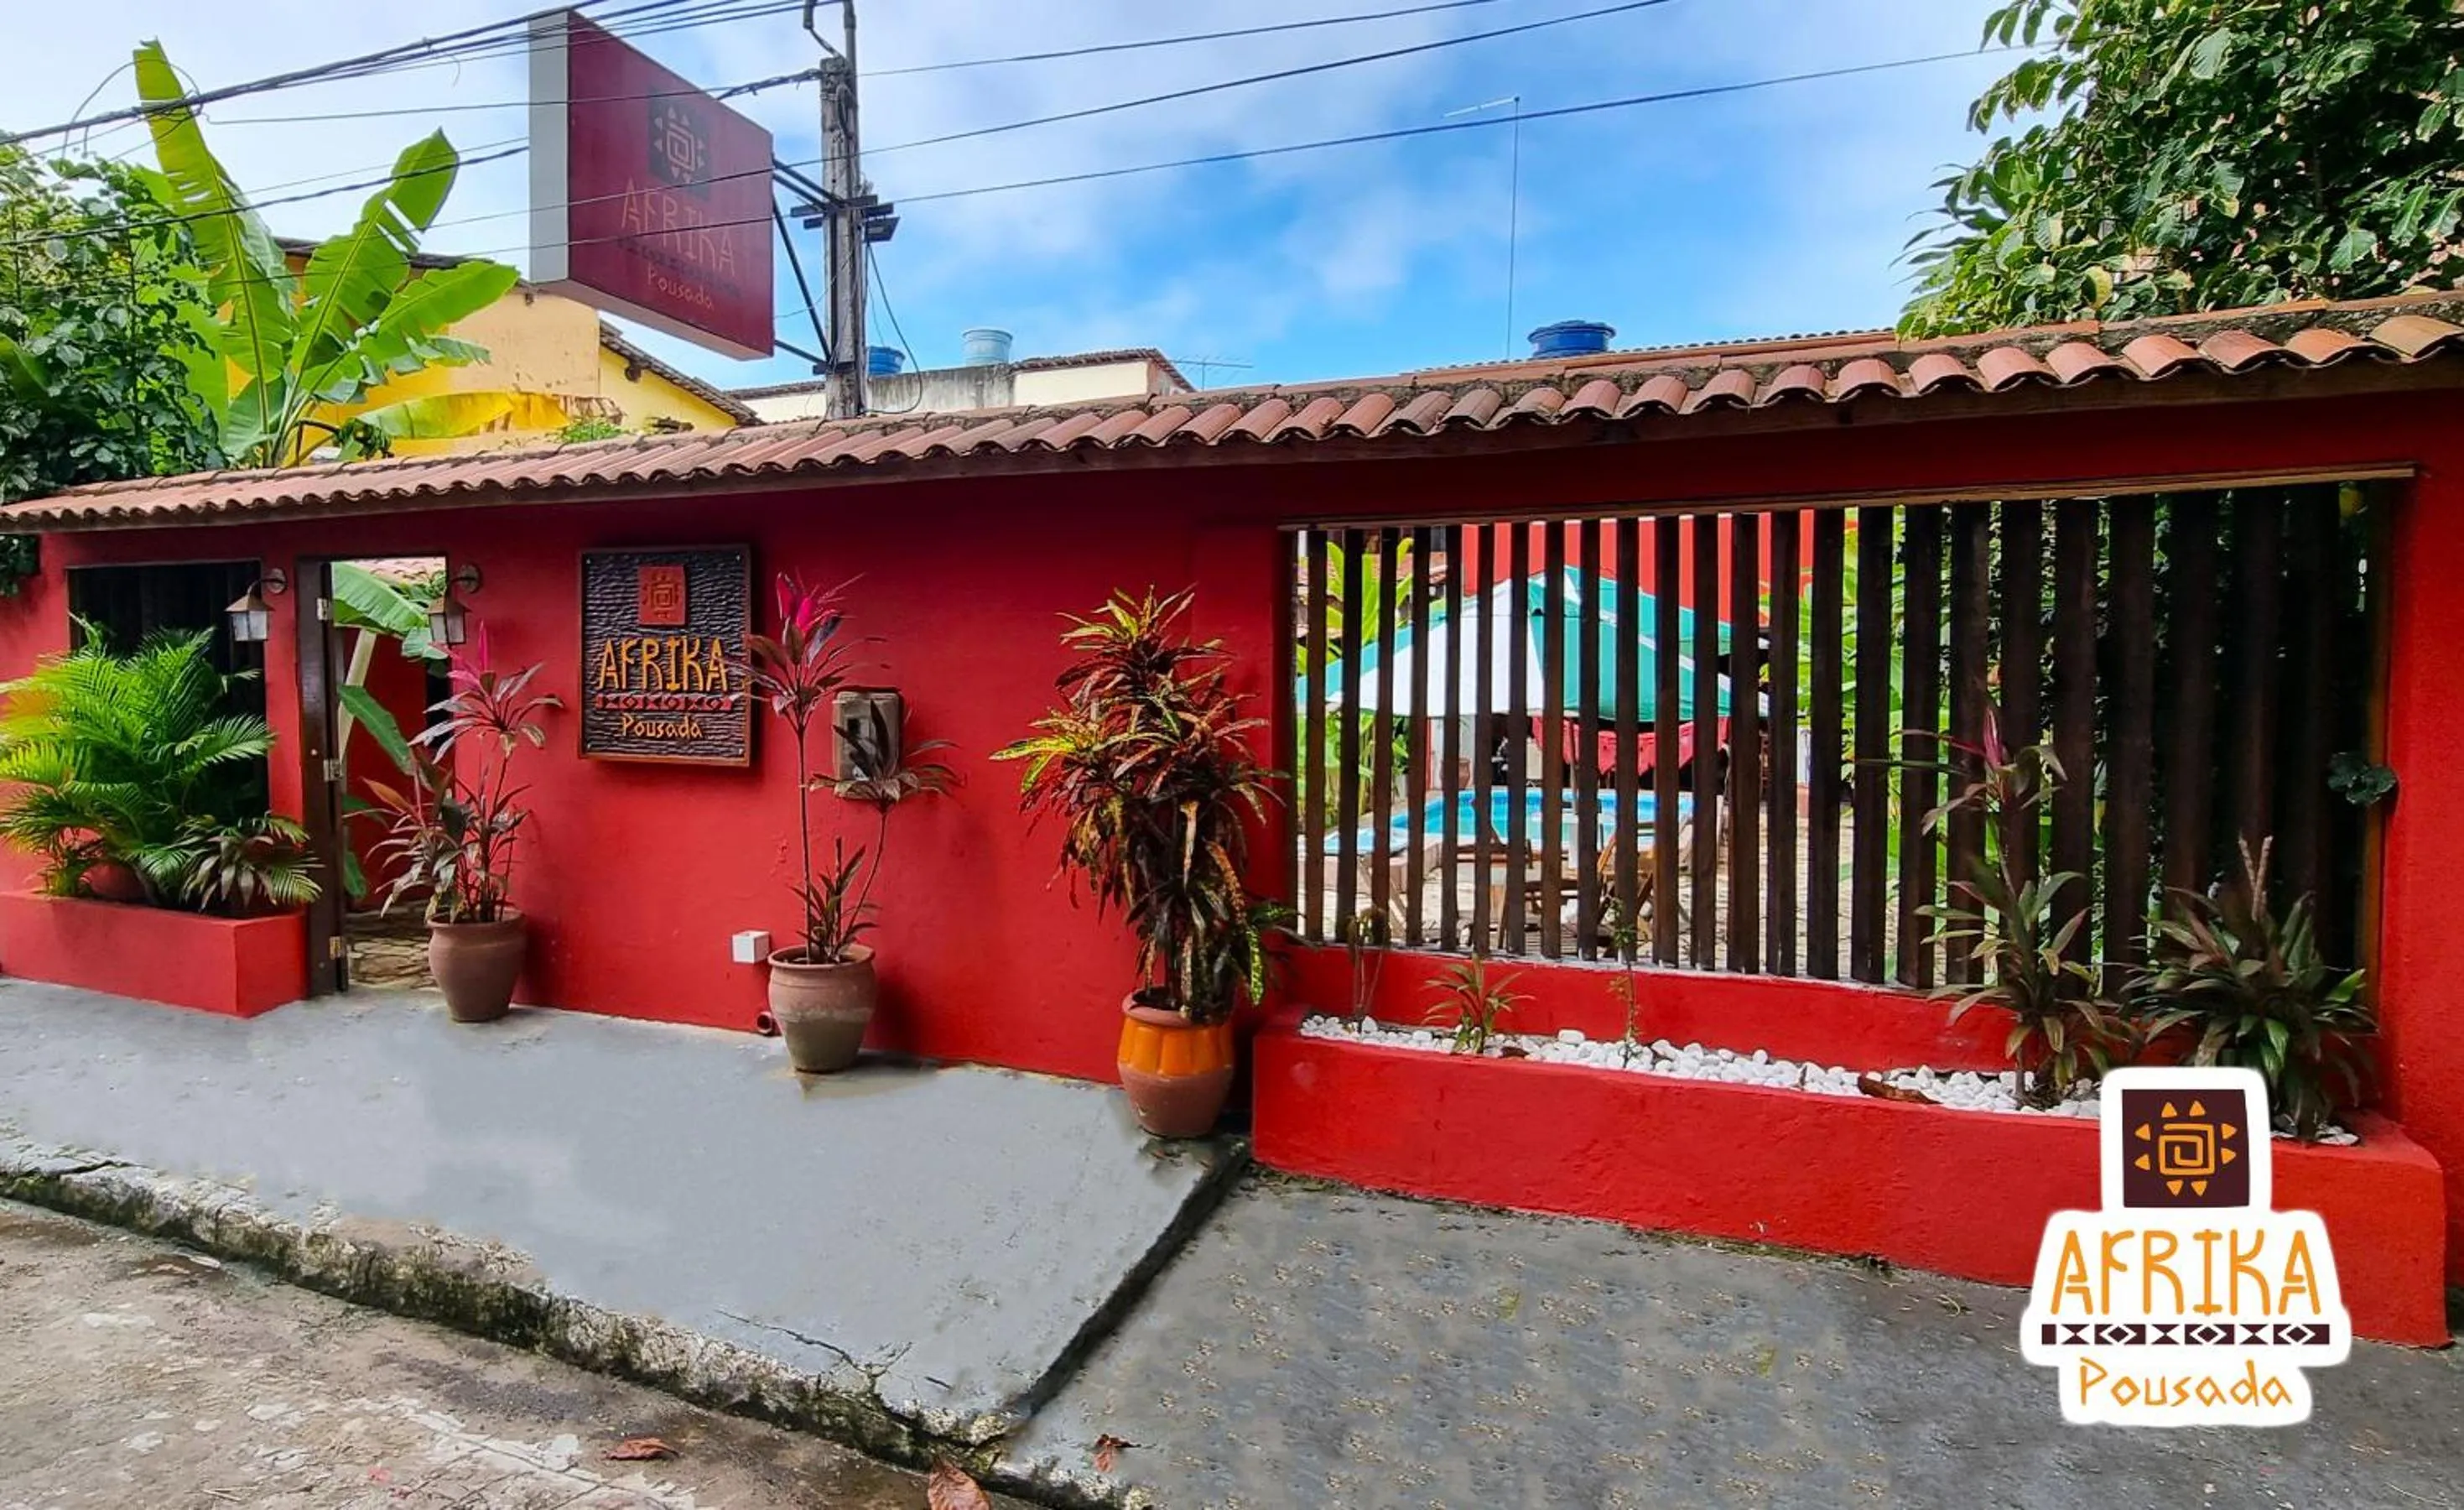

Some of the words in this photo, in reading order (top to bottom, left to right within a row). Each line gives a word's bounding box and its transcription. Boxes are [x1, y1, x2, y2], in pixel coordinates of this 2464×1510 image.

[621, 176, 736, 278] AFRIKA
[647, 263, 713, 309] Pousada
[598, 636, 728, 691] AFRIKA
[622, 713, 703, 739] Pousada
